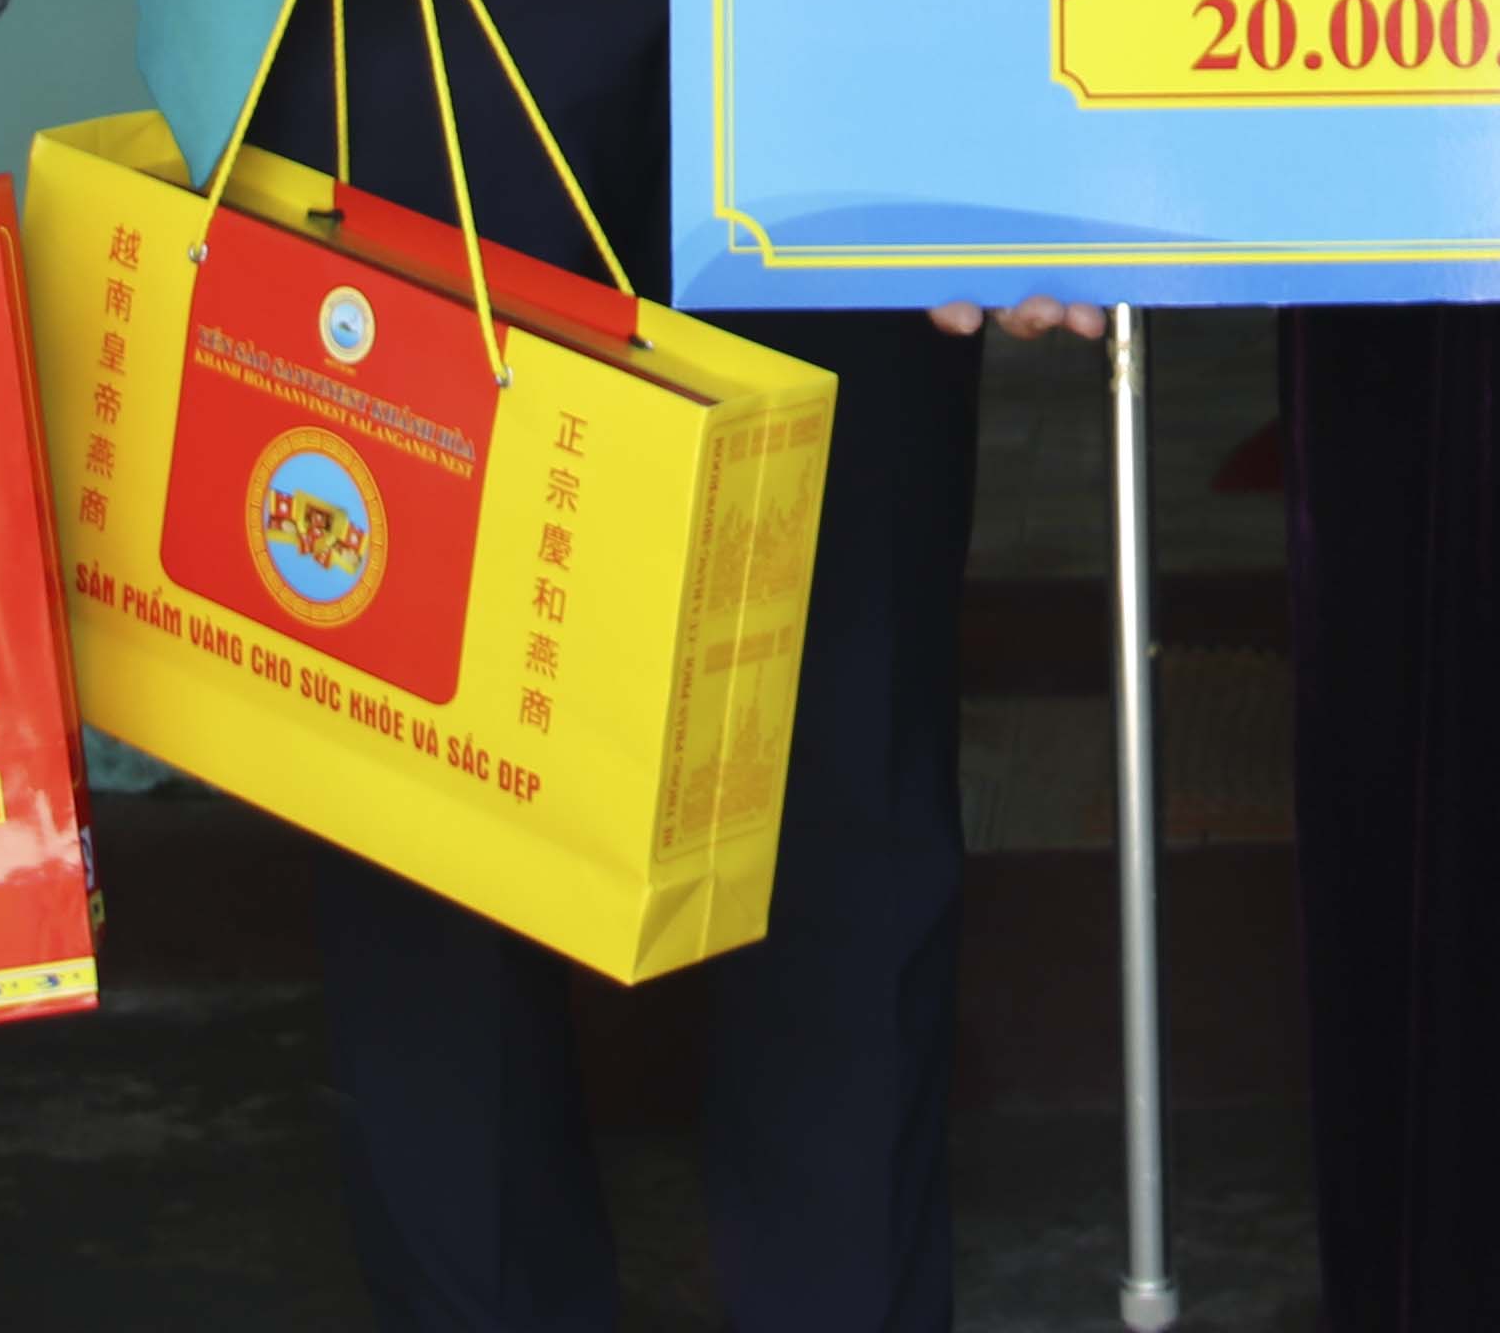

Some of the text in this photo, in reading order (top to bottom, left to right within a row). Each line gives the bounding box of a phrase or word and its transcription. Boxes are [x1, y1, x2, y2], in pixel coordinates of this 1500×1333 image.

[350, 412, 438, 462] SALANGANES
[439, 450, 474, 479] NEST
[74, 557, 541, 807] SẢN PHẨM VÀNG CHO SỨC KHỎE VÀ SẮC ĐẸP
